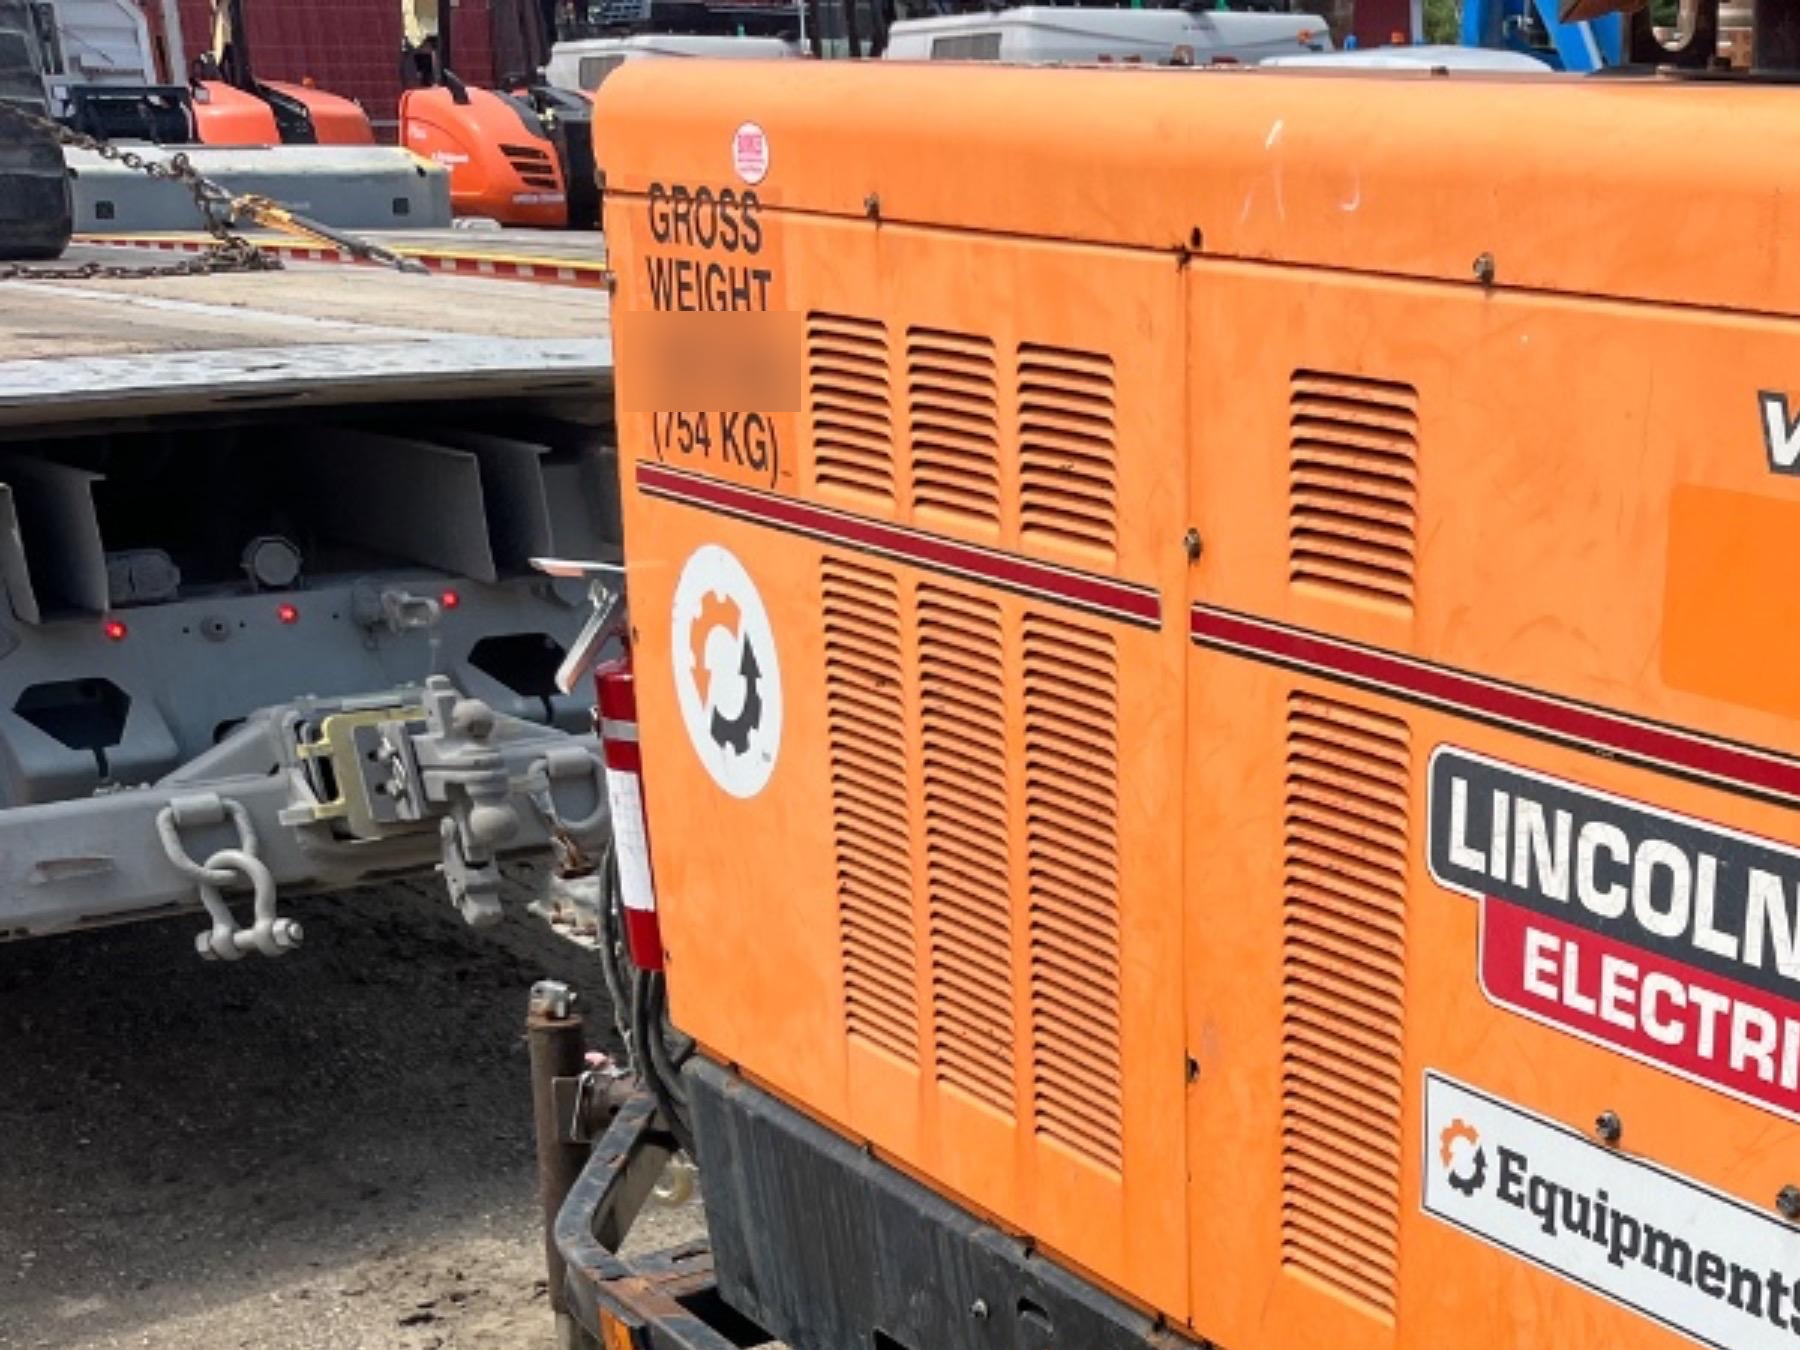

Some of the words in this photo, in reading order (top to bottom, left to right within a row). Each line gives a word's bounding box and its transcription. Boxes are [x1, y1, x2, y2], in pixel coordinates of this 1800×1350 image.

[648, 182, 762, 255] GROSS
[645, 255, 772, 311] WEIGHT
[720, 412, 778, 489] KG)
